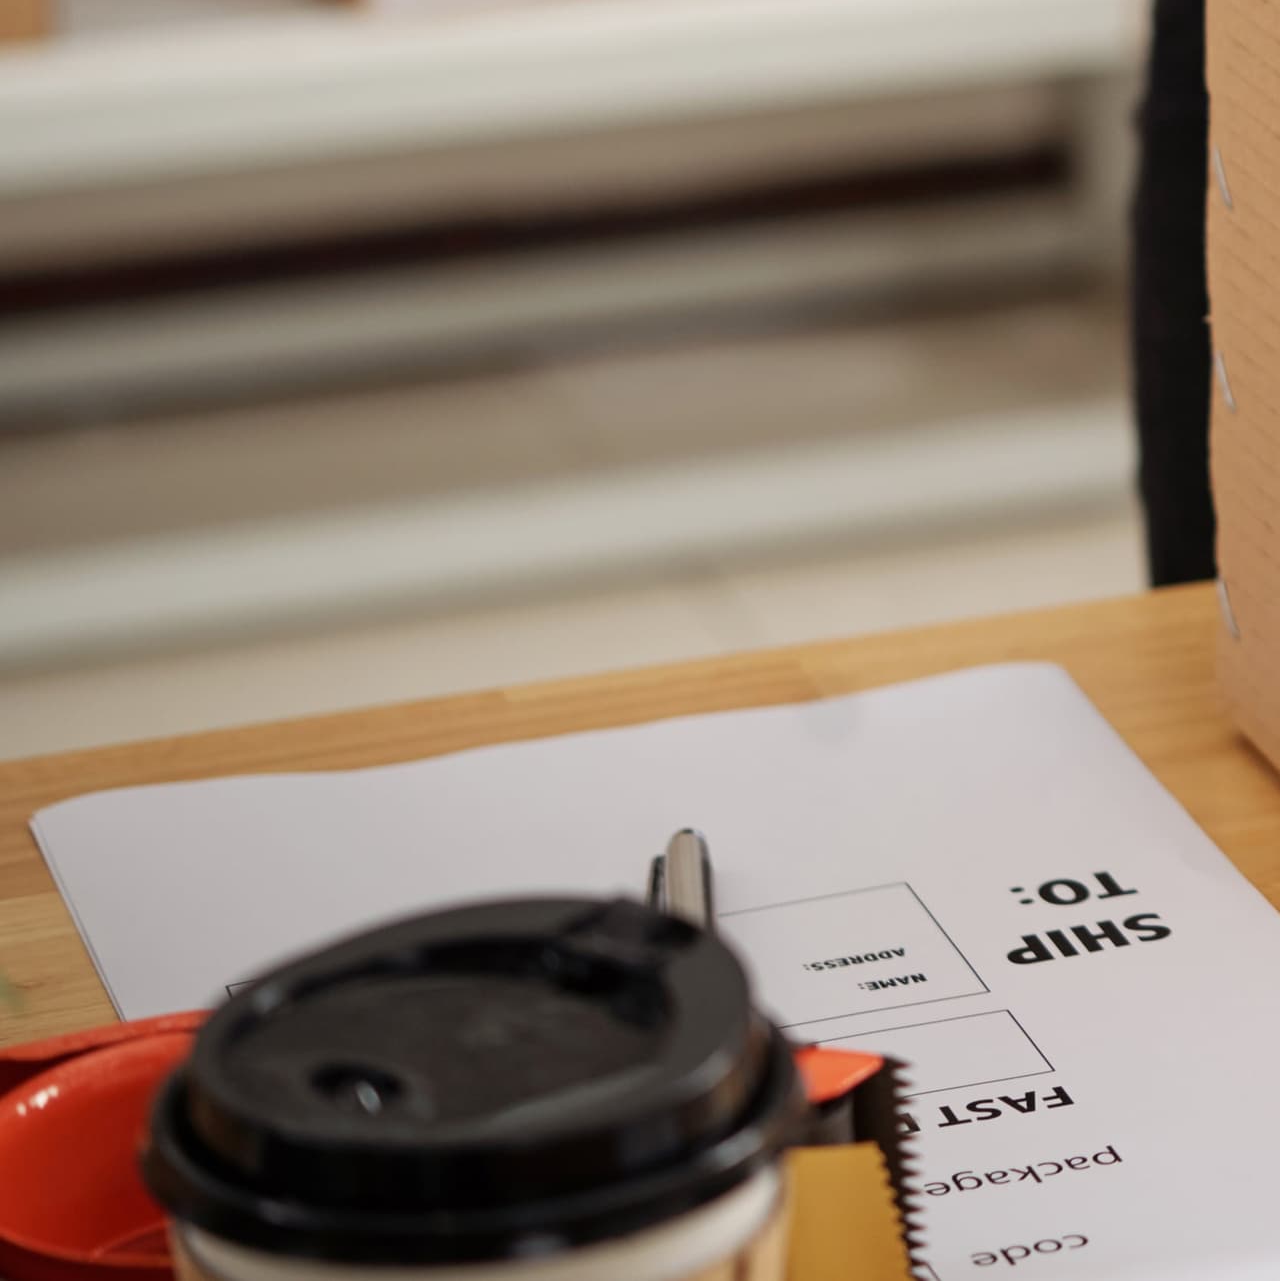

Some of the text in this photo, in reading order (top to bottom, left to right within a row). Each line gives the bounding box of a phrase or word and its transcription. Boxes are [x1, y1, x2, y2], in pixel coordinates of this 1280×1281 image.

[1009, 871, 1139, 905] TO:
[1006, 913, 1172, 965] SHIP
[803, 947, 907, 972] ADDRESS:
[857, 973, 928, 991] NAME:
[938, 1086, 1075, 1128] FAST
[924, 1145, 1123, 1197] package
[970, 1234, 1089, 1266] code
